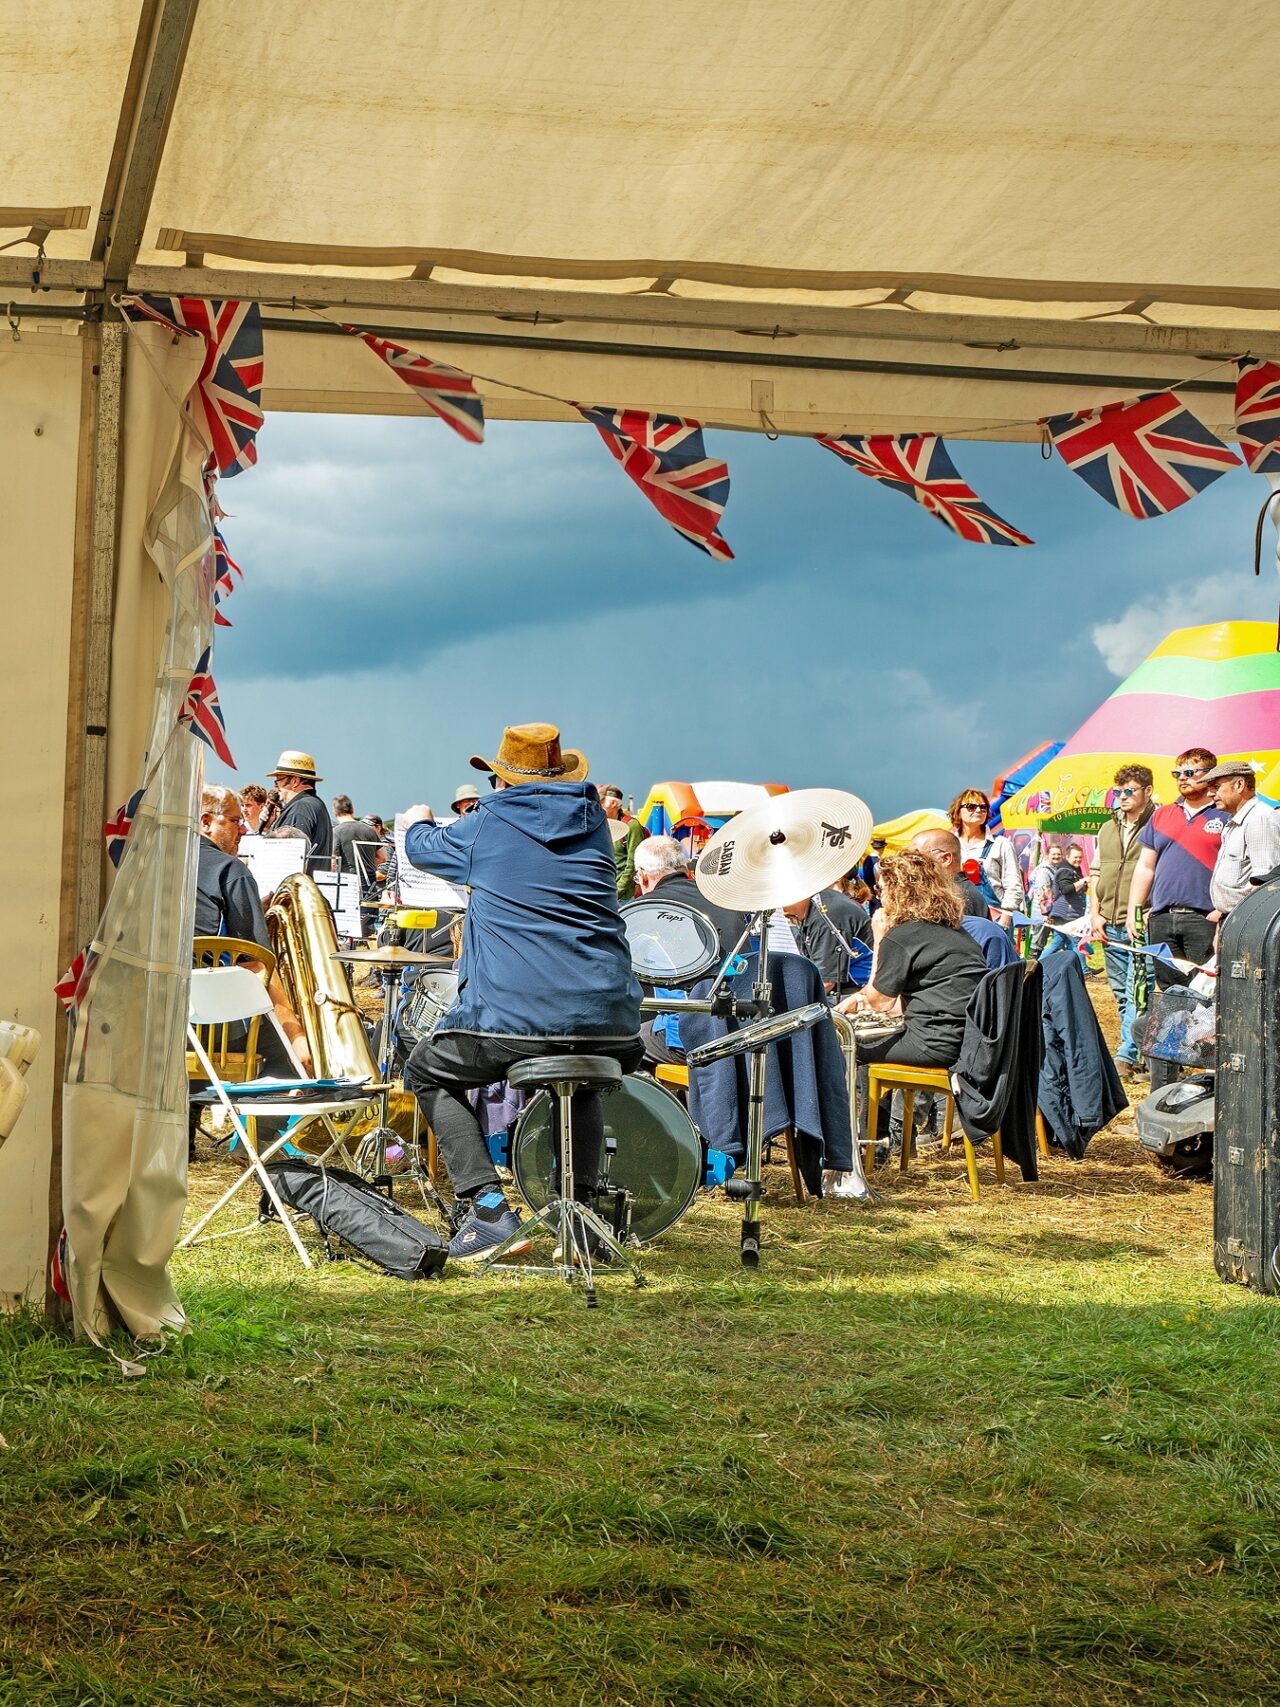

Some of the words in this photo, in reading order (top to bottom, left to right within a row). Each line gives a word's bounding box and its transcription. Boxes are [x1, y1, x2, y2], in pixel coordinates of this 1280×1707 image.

[1052, 814, 1062, 822] TO
[1063, 807, 1086, 818] THERE
[1080, 821, 1102, 829] STAT
[718, 840, 735, 876] SABIAN
[657, 911, 686, 923] Traps
